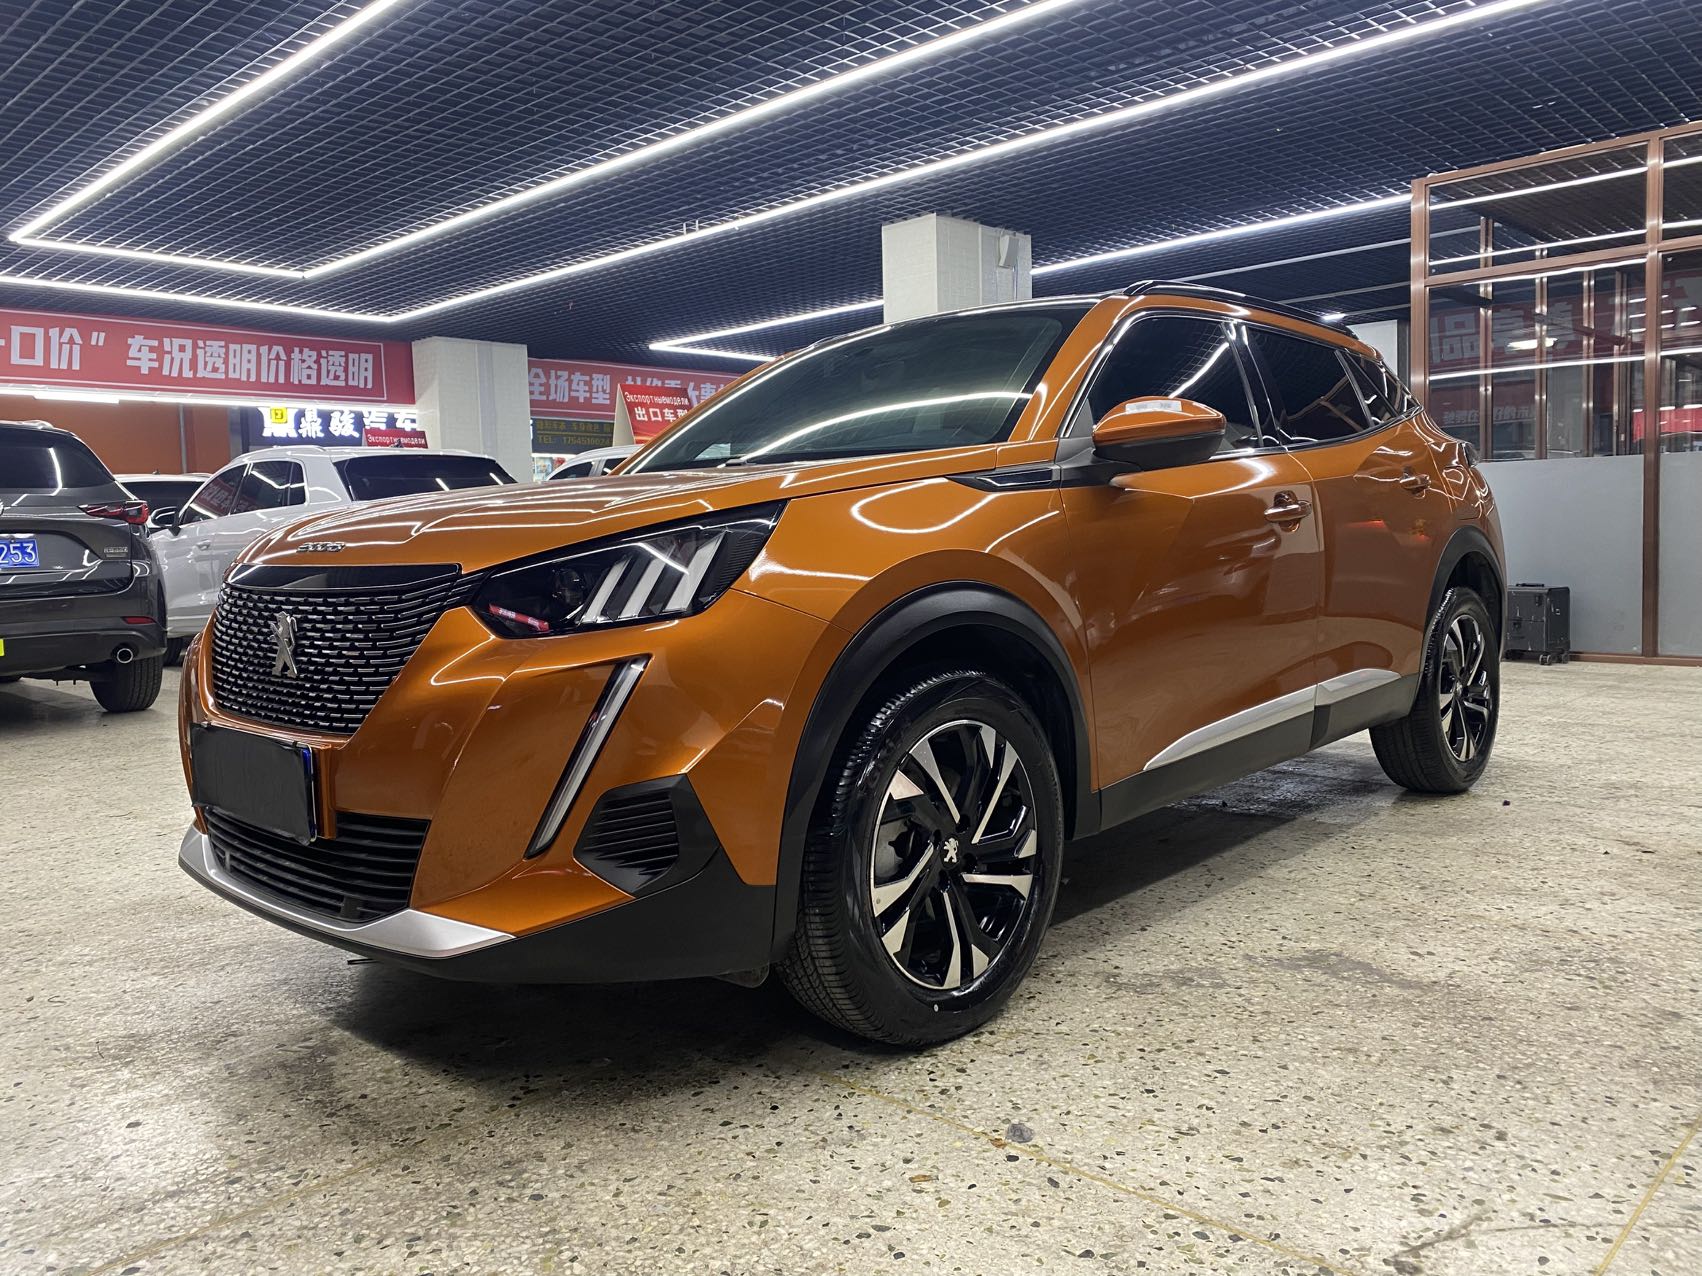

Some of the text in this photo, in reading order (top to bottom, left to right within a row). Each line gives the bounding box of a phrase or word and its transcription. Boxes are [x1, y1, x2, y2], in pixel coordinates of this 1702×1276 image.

[0, 325, 374, 389] 口价” 车况透明价格透明
[528, 368, 611, 405] 全场车型
[0, 543, 36, 563] 253
